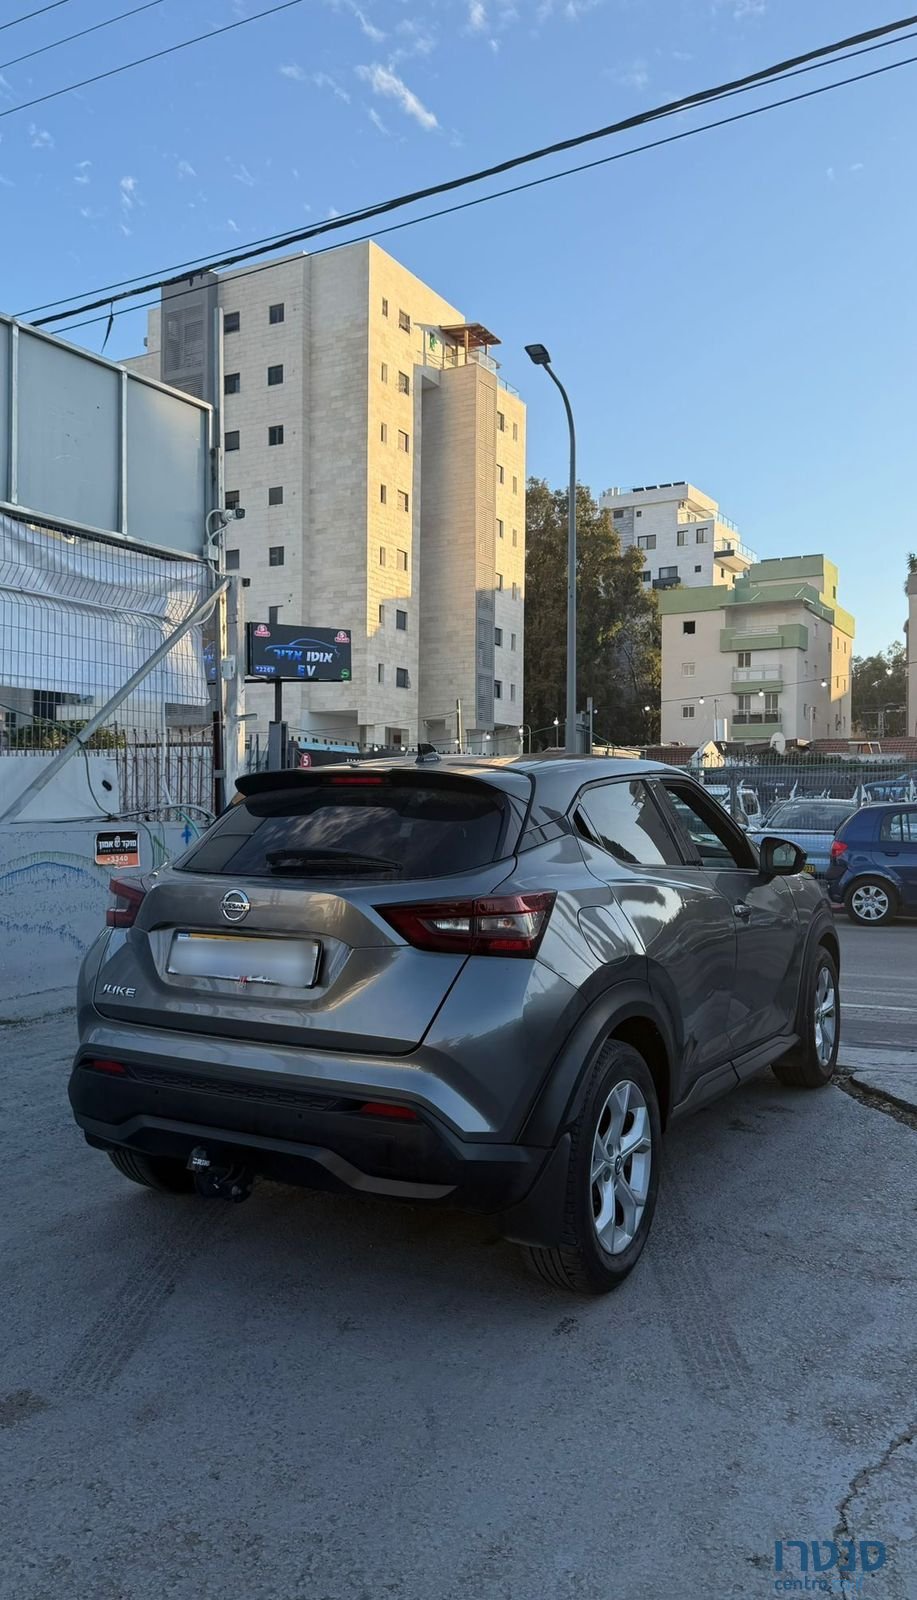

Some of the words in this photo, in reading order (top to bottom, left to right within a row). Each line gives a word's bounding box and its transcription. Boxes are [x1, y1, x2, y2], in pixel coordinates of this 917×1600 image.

[273, 649, 303, 662] אדיר
[306, 651, 334, 663] אוטו
[99, 841, 114, 850] אמון
[121, 840, 137, 848] מוקד
[222, 902, 247, 910] NISSAN
[102, 984, 136, 998] JUKE
